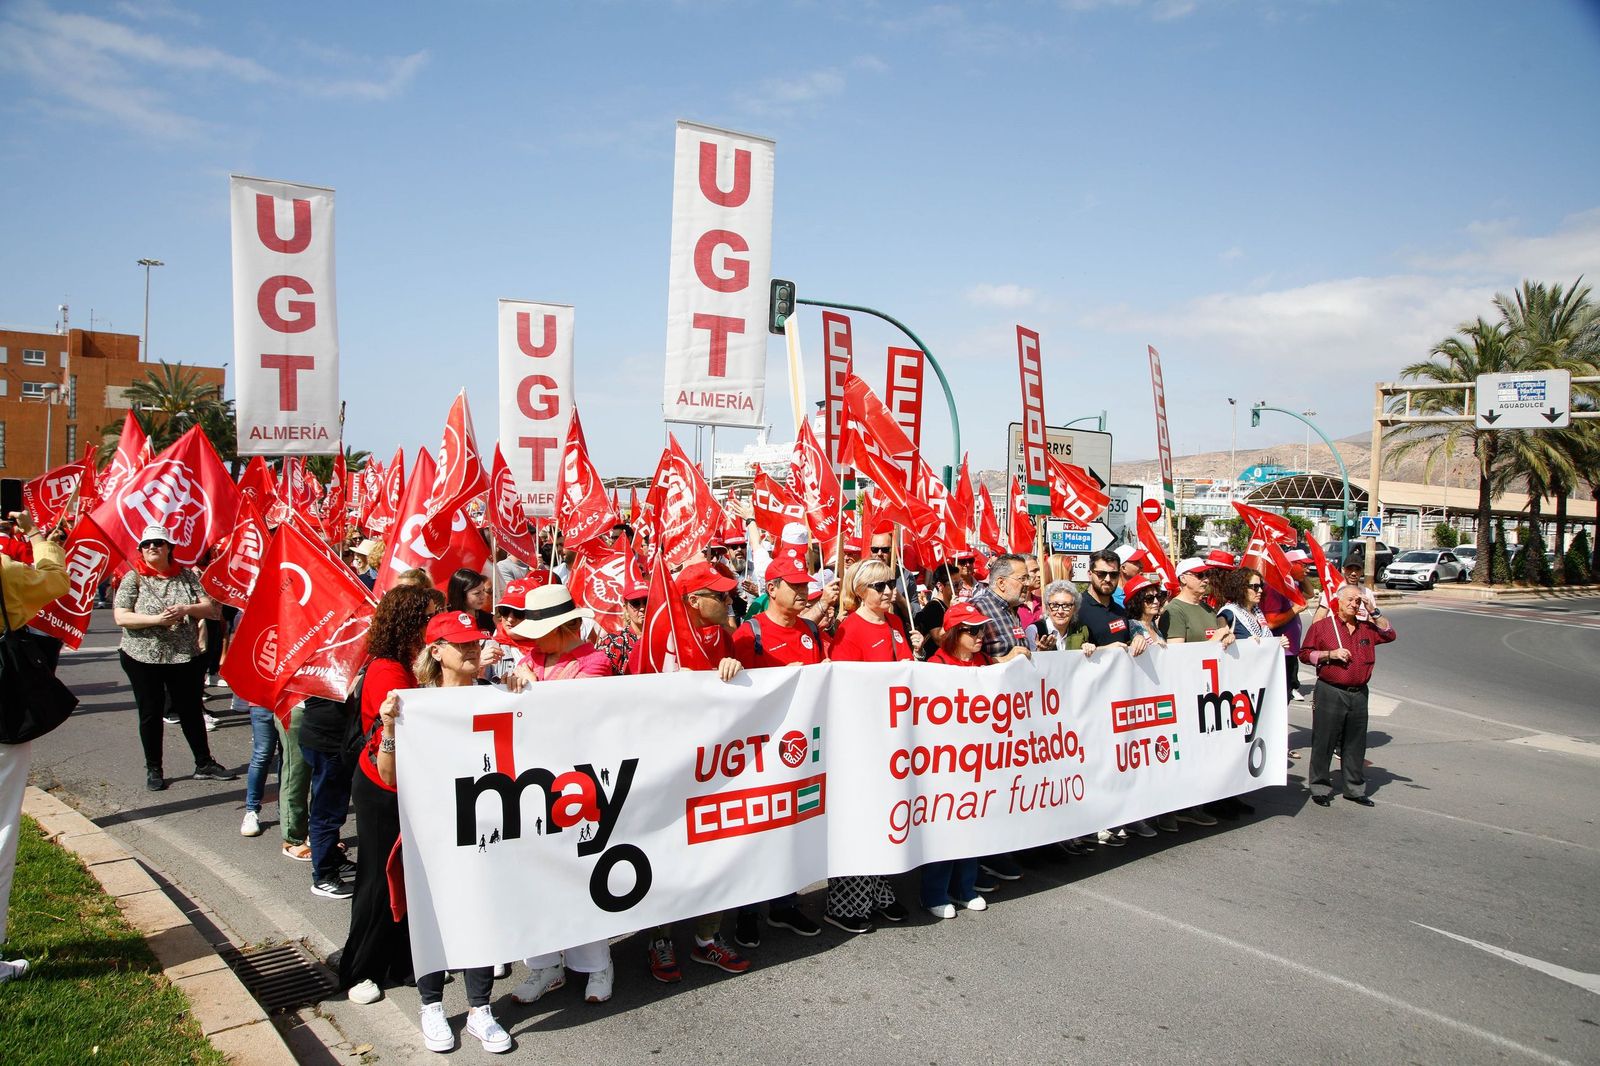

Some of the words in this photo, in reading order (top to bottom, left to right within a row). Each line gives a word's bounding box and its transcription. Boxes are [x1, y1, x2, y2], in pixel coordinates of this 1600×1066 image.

[692, 141, 752, 378] UGT
[255, 193, 317, 412] UGT
[516, 312, 560, 482] UGT
[676, 389, 754, 411] ALMERÍA
[1020, 334, 1046, 481] CCOO
[249, 423, 329, 440] ALMERÍA
[754, 489, 804, 519] COO
[888, 685, 1034, 734] Proteger
[1040, 678, 1060, 717] lo
[1115, 702, 1156, 727] CCOO
[693, 733, 771, 783] UGT
[889, 721, 1085, 783] conquistado,
[1115, 738, 1152, 773] UGT
[693, 791, 792, 835] CCOO
[887, 789, 997, 845] ganar
[1008, 773, 1085, 815] futuro
